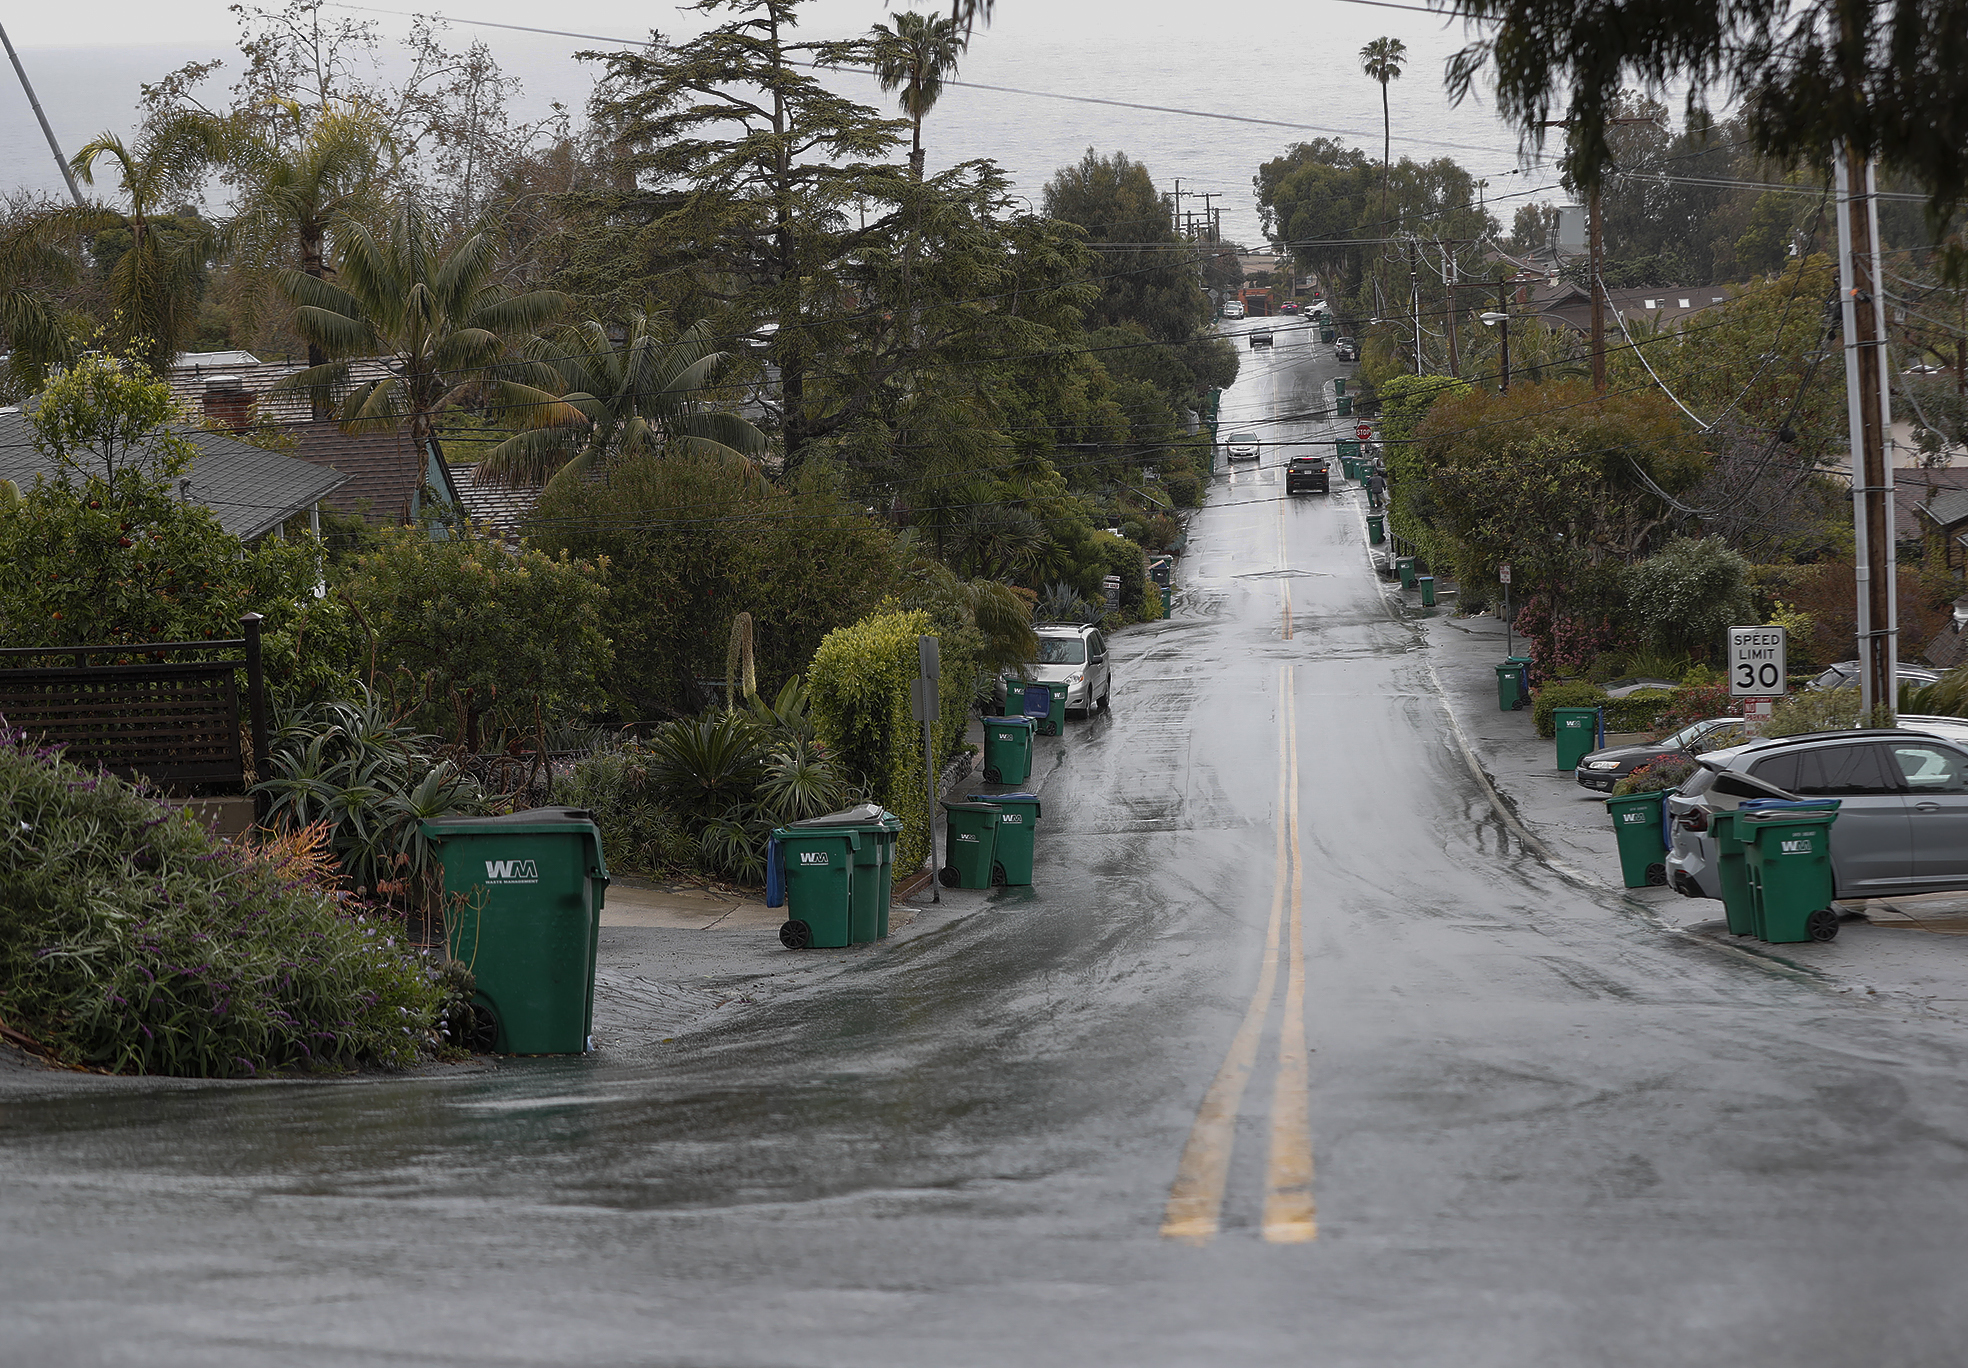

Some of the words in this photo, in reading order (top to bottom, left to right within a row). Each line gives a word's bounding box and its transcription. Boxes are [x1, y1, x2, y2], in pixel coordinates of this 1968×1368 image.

[1734, 634, 1780, 646] SPEED
[1738, 648, 1775, 660] LIMIT
[1735, 663, 1779, 689] 30
[1002, 814, 1022, 822] WM
[1781, 840, 1812, 851] WM
[800, 852, 829, 862] WM
[485, 859, 538, 878] WM
